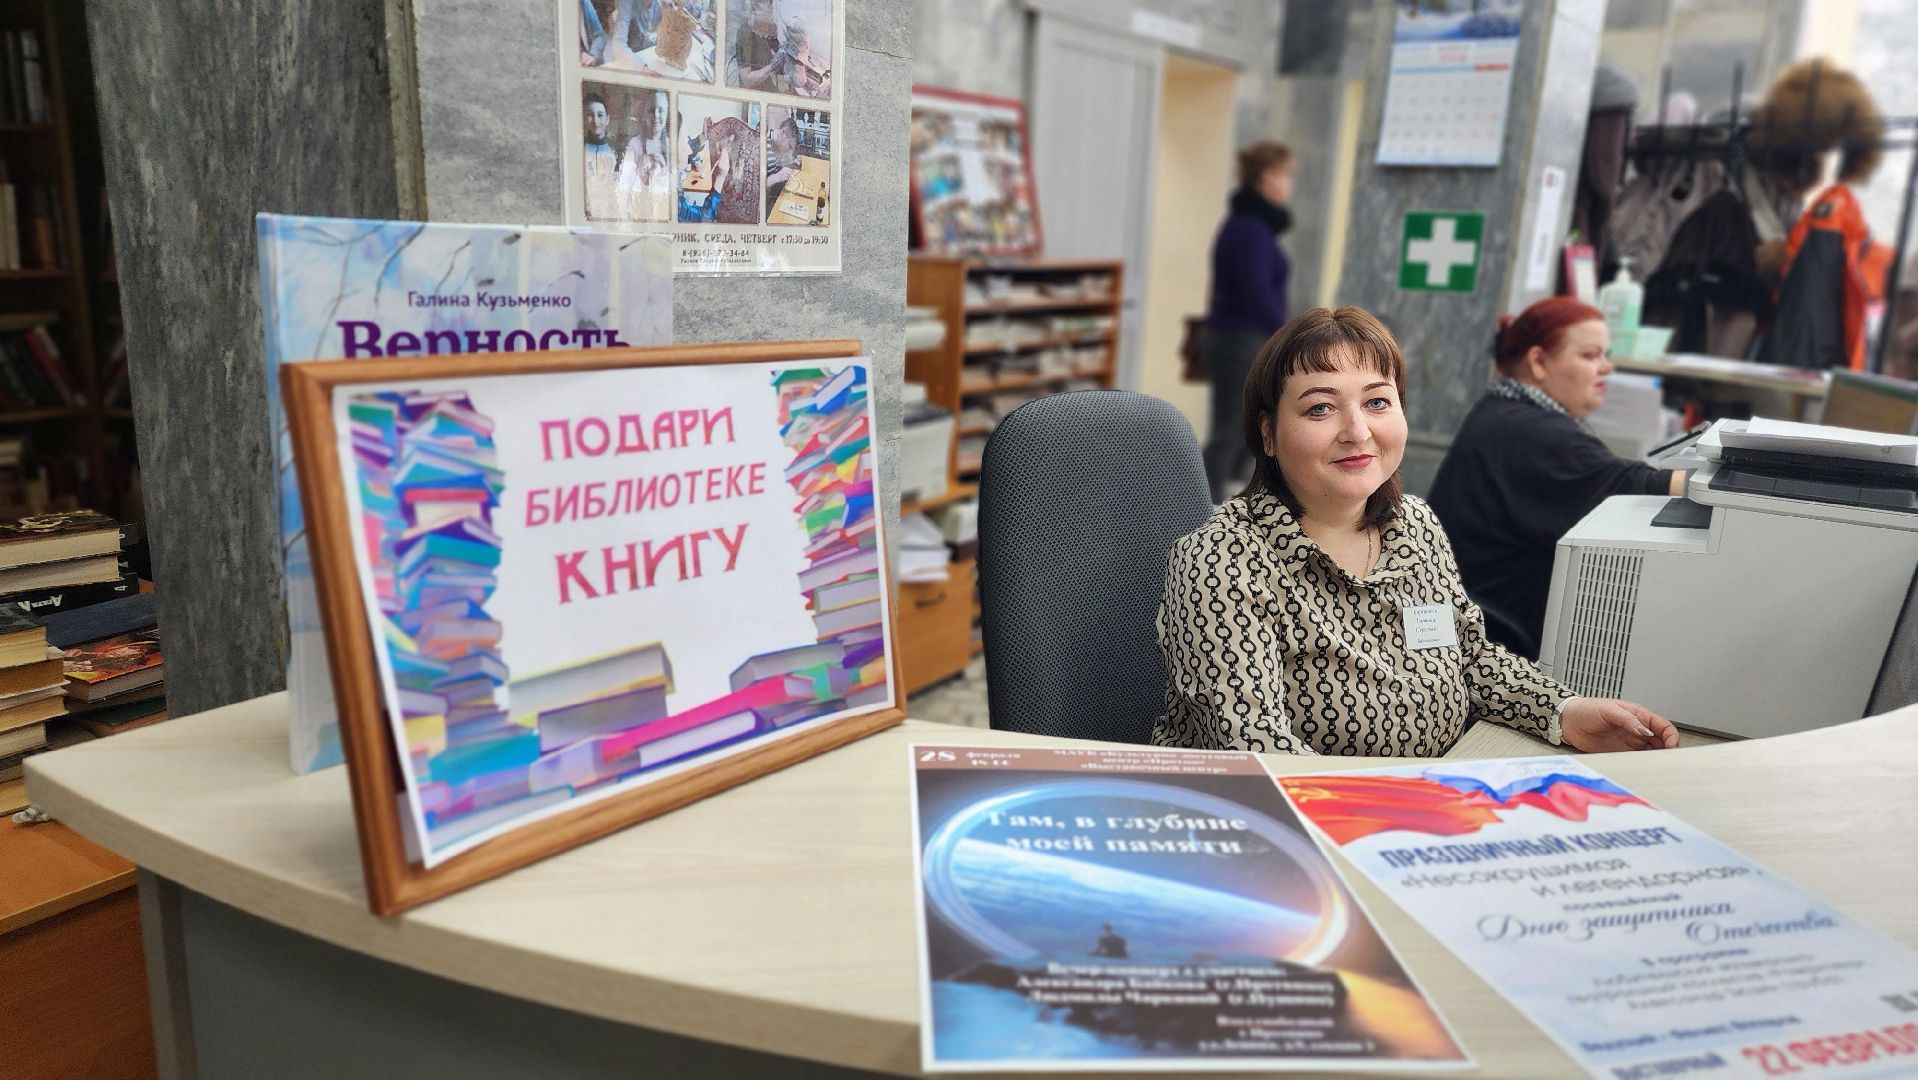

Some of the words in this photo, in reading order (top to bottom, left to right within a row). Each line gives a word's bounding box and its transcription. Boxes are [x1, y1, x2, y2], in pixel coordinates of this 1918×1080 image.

[704, 233, 736, 245] СРЕДА,
[740, 233, 777, 244] ЧЕТВЕРГ
[811, 235, 829, 245] 19:30
[408, 291, 470, 307] Галина
[476, 291, 571, 311] Кузьменко
[539, 407, 735, 461] ПОДАРИ
[525, 462, 766, 527] БИБЛИОТЕКЕ
[554, 523, 750, 604] КНИГУ
[986, 811, 1066, 829] Там,
[1075, 816, 1097, 828] в
[1105, 814, 1249, 833] глубине
[1005, 835, 1095, 851] моей
[1104, 839, 1243, 854] памяти
[1379, 835, 1568, 870] ПРАЗДНИЧНЫЙ
[1565, 827, 1683, 855] КОНЦЕРТ
[1401, 858, 1631, 889] «Несокрушимая
[1476, 913, 1570, 942] Дню
[1572, 903, 1736, 941] защитника
[1741, 1044, 1804, 1075] 22
